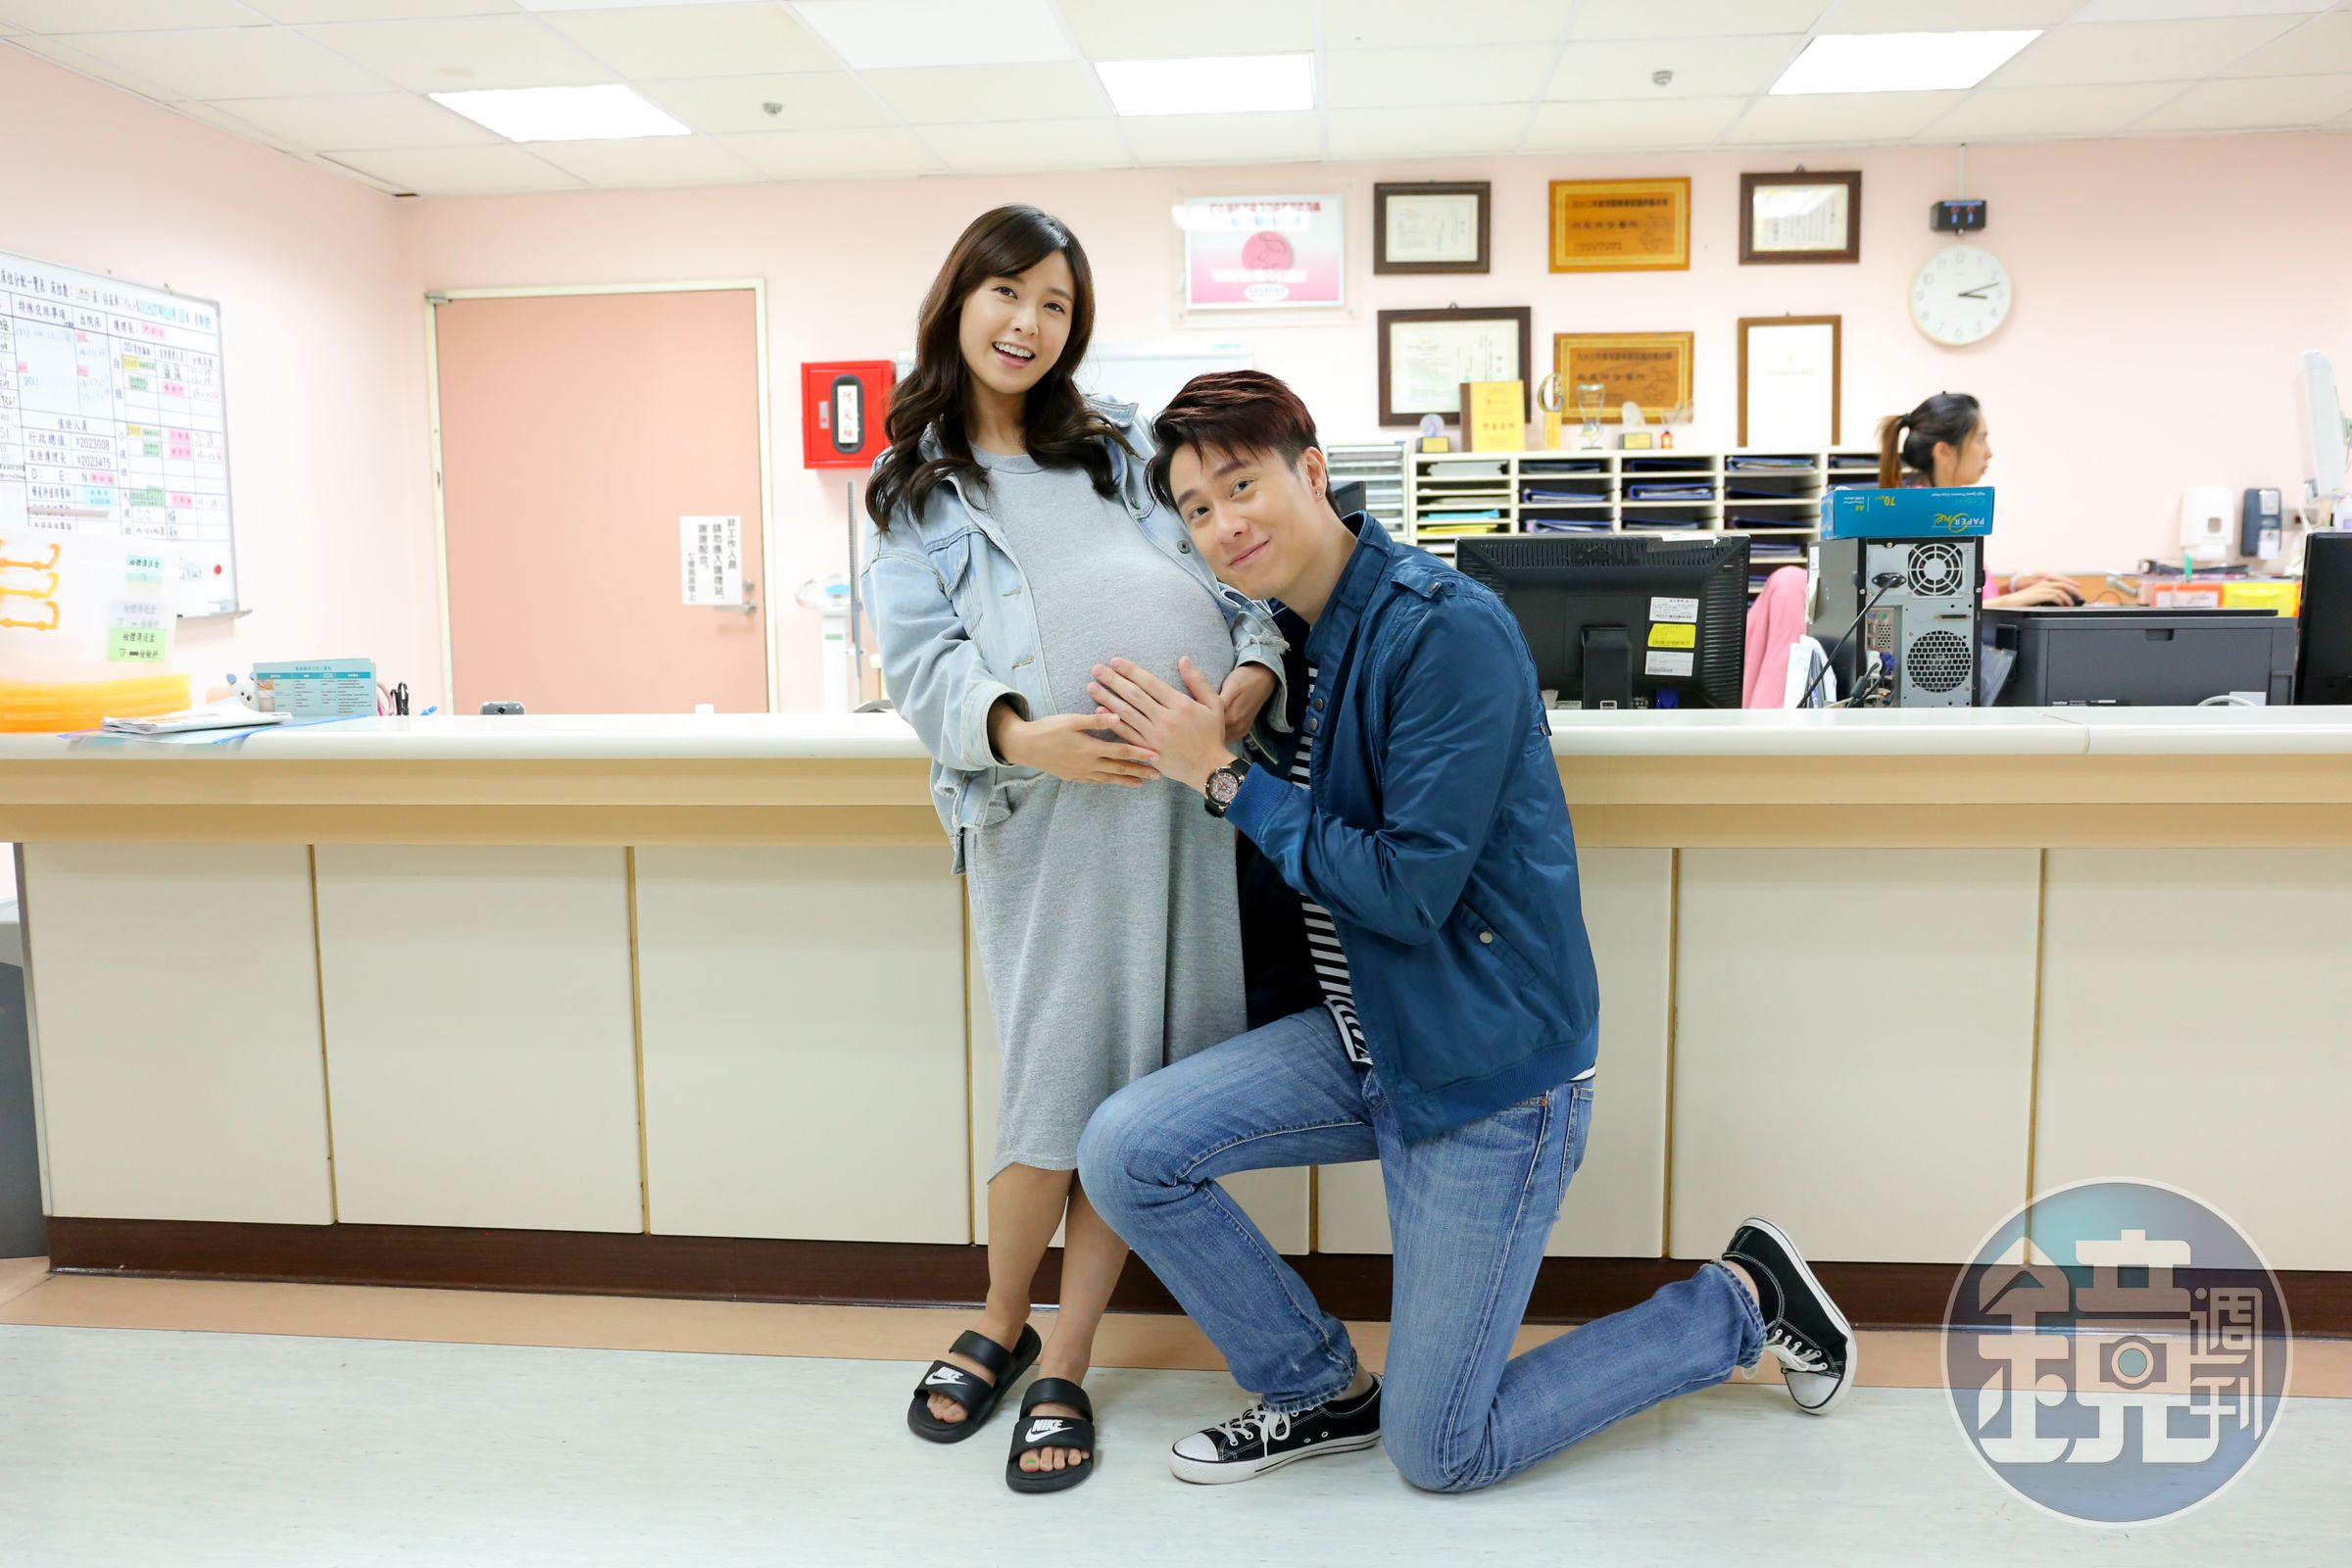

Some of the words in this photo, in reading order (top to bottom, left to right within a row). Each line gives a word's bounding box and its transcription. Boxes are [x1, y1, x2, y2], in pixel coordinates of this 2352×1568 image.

[1954, 516, 1985, 526] PAPER
[727, 517, 737, 569] 非工作人員
[1570, 546, 1642, 564] DELL
[935, 1365, 964, 1381] NIKE
[1032, 1418, 1064, 1432] NIKE
